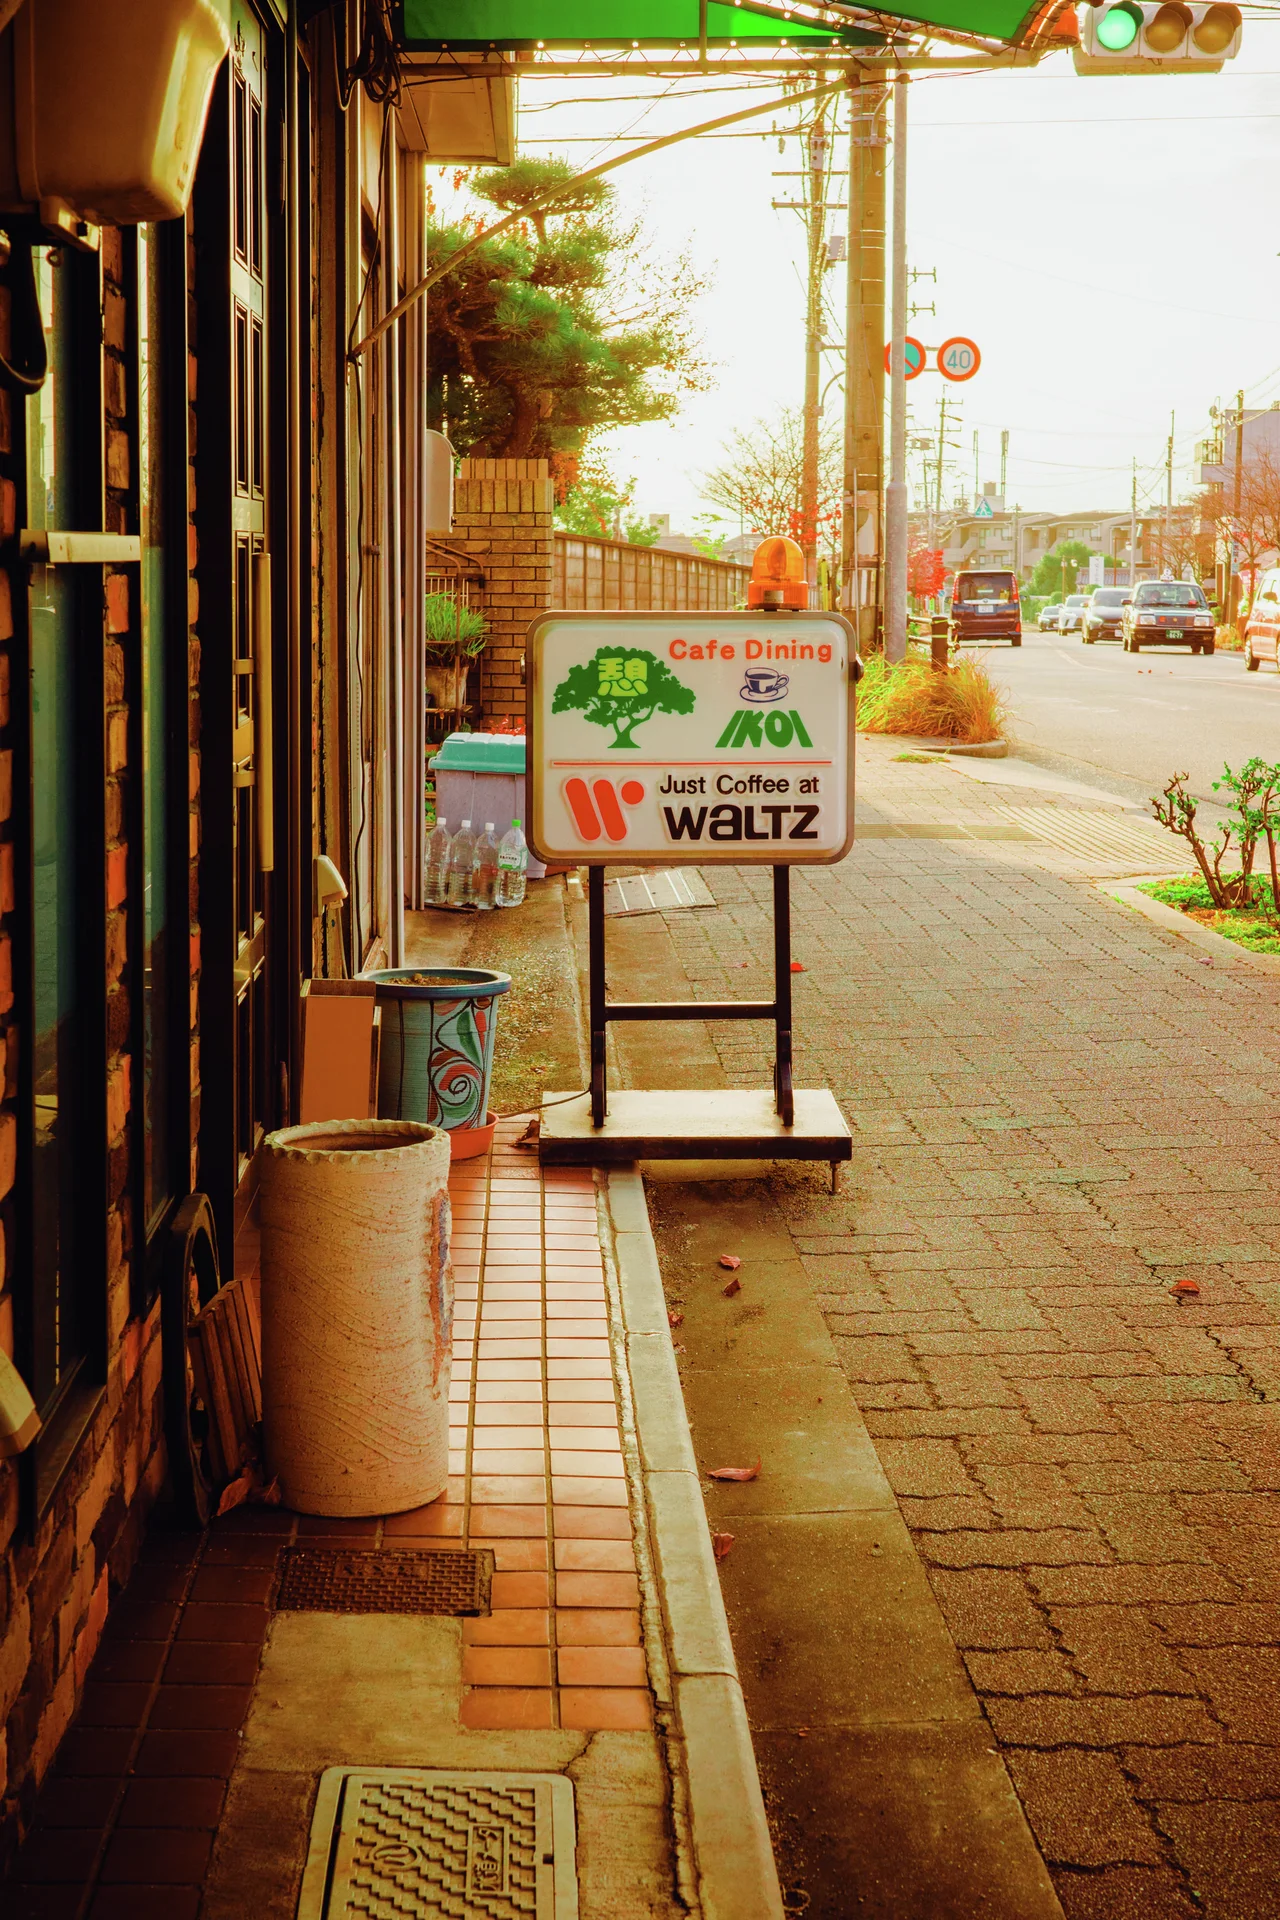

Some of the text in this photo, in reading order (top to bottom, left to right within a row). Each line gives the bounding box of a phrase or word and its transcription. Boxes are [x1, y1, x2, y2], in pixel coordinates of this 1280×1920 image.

[947, 350, 971, 369] 40
[669, 639, 832, 663] Cafe Dining
[598, 657, 648, 697] 憩
[715, 710, 813, 748] IKOI
[659, 775, 820, 794] Just Coffee at
